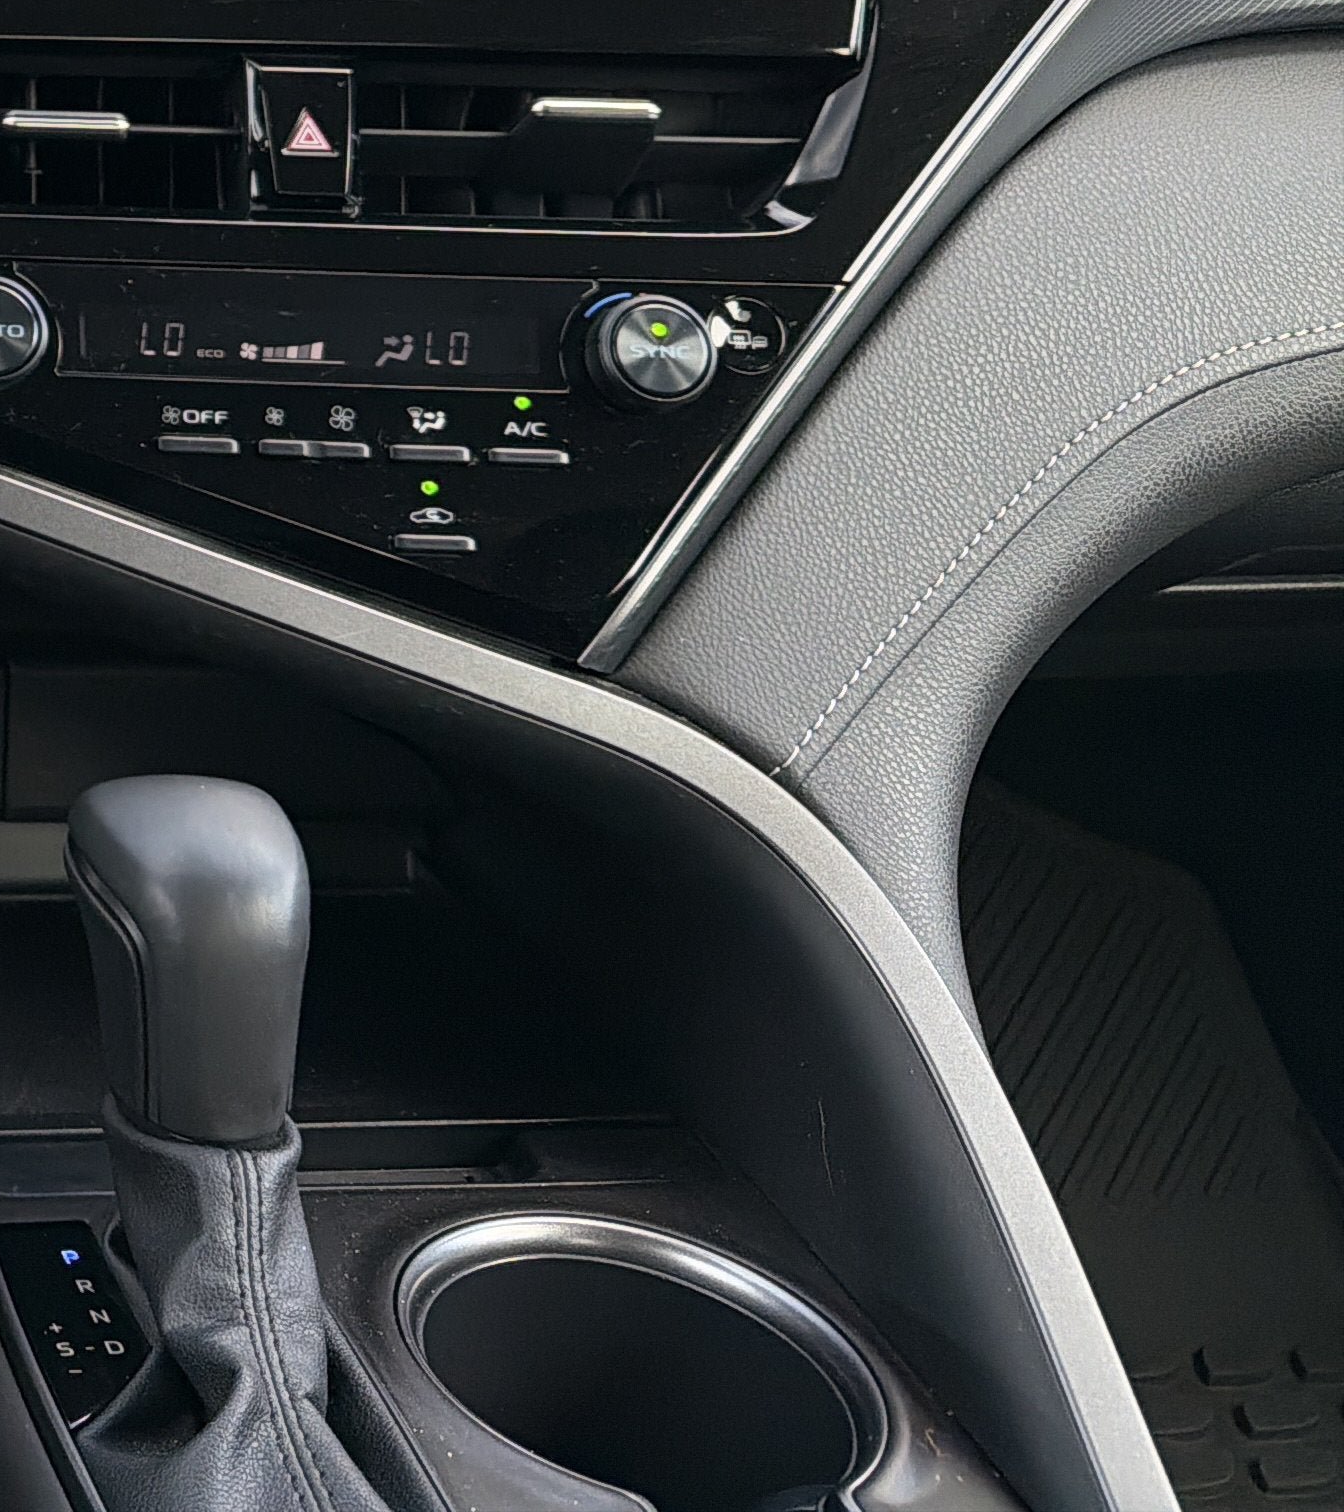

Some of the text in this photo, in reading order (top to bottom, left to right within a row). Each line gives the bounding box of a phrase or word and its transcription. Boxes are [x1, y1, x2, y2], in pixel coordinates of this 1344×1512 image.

[140, 322, 185, 357] LO
[196, 348, 226, 358] ECO
[426, 331, 469, 366] LO
[628, 343, 690, 360] SYNC
[182, 409, 229, 425] OFF
[504, 420, 548, 437] A/C
[61, 1250, 80, 1265] P
[75, 1279, 95, 1293] R
[89, 1309, 111, 1324] N
[56, 1341, 75, 1357] S
[104, 1341, 125, 1355] D
